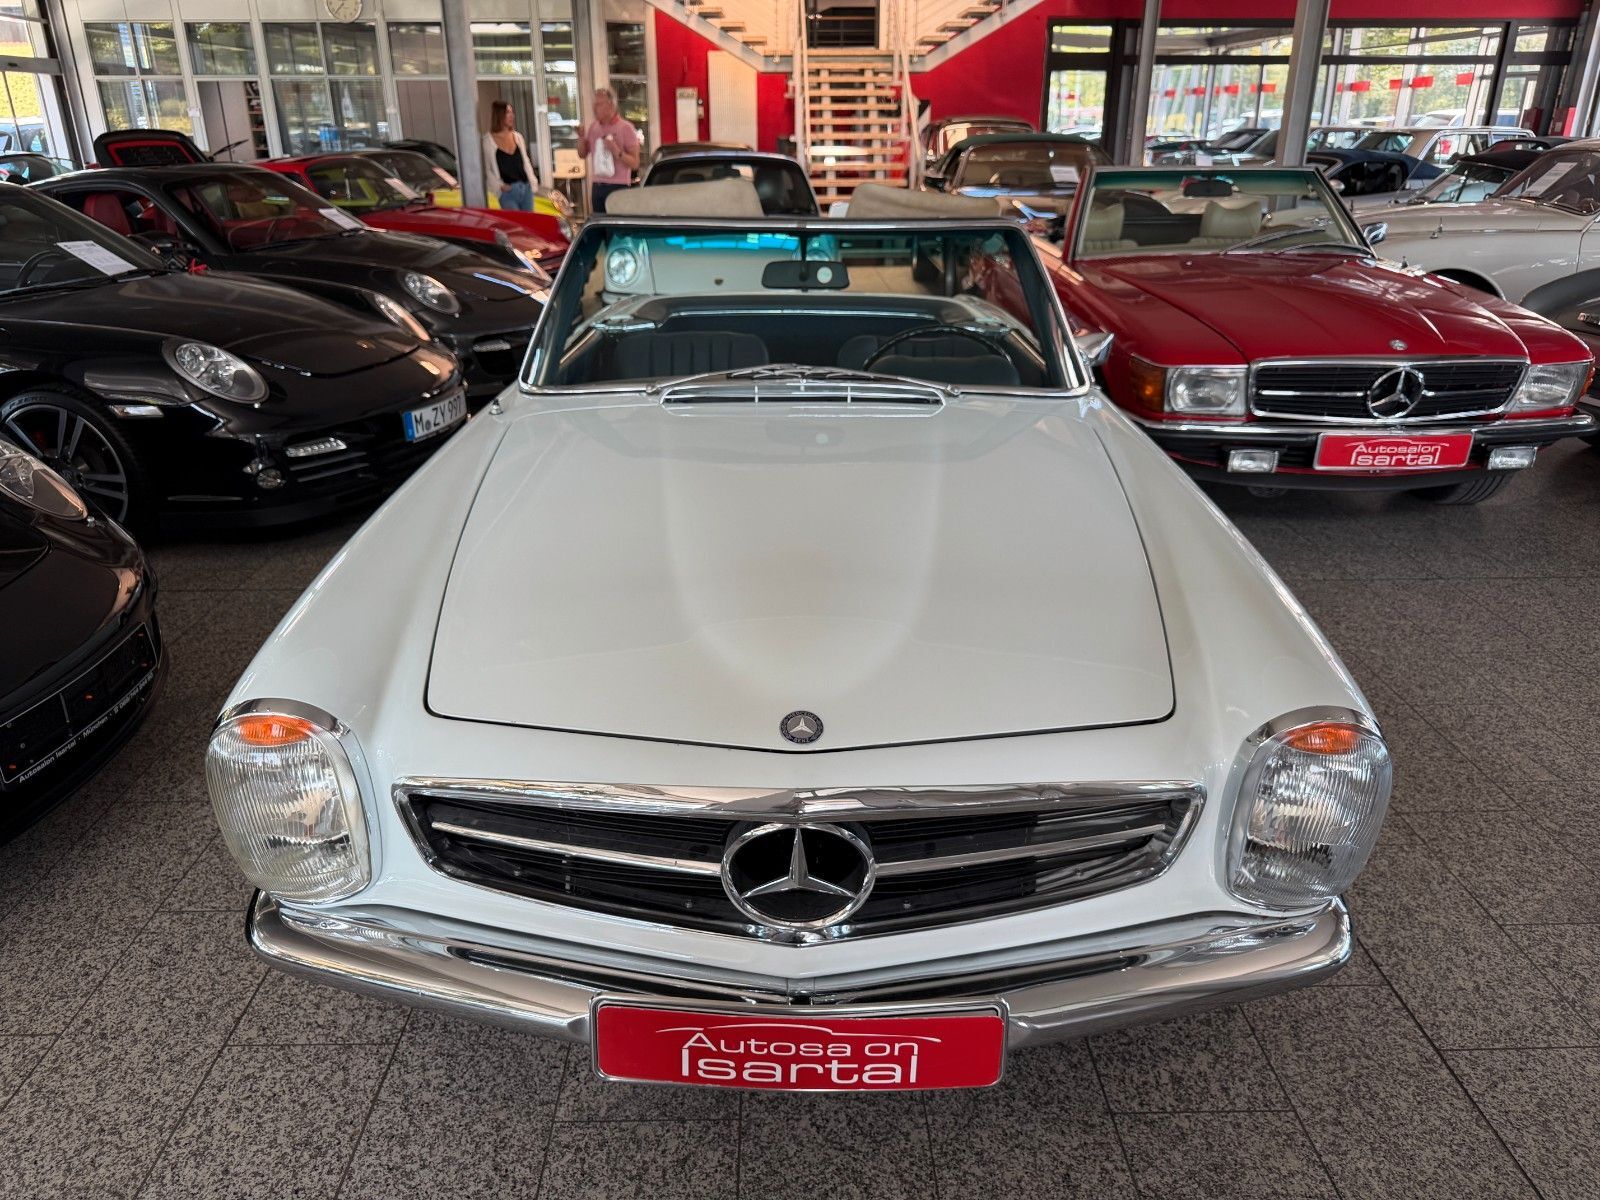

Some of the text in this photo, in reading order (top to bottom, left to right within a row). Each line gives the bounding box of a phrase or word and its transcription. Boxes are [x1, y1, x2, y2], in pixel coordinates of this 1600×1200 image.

[414, 412, 425, 433] M
[432, 403, 445, 427] ZY
[1350, 451, 1440, 466] Isartal
[1354, 443, 1442, 454] Autosalon
[681, 1048, 918, 1085] Isartal
